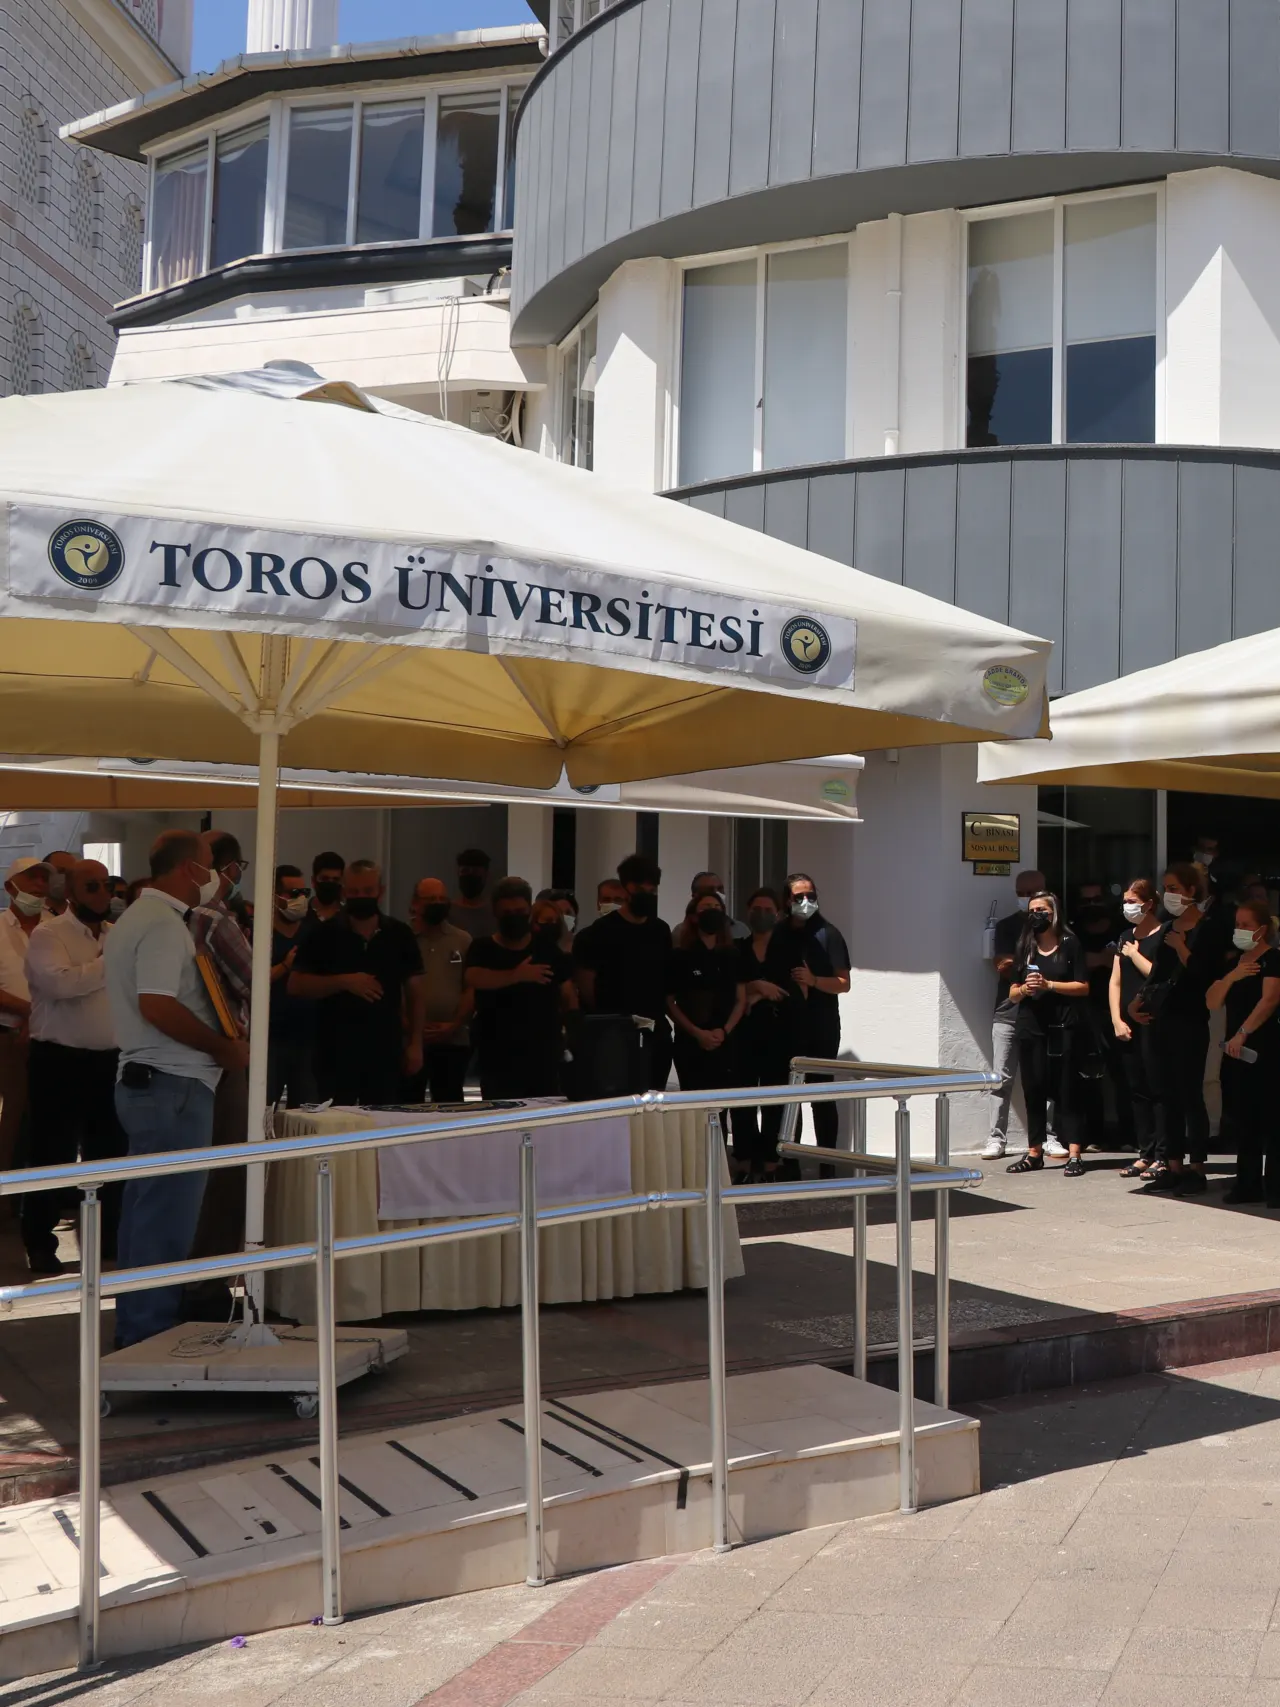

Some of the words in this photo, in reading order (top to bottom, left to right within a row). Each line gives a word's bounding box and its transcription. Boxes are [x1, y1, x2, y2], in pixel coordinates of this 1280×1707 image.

[54, 529, 74, 550] TOROS
[149, 540, 372, 604] TOROS
[393, 555, 764, 657] ÜNİVERSİTESİ
[970, 820, 982, 836] C
[971, 844, 997, 852] SOSYAL
